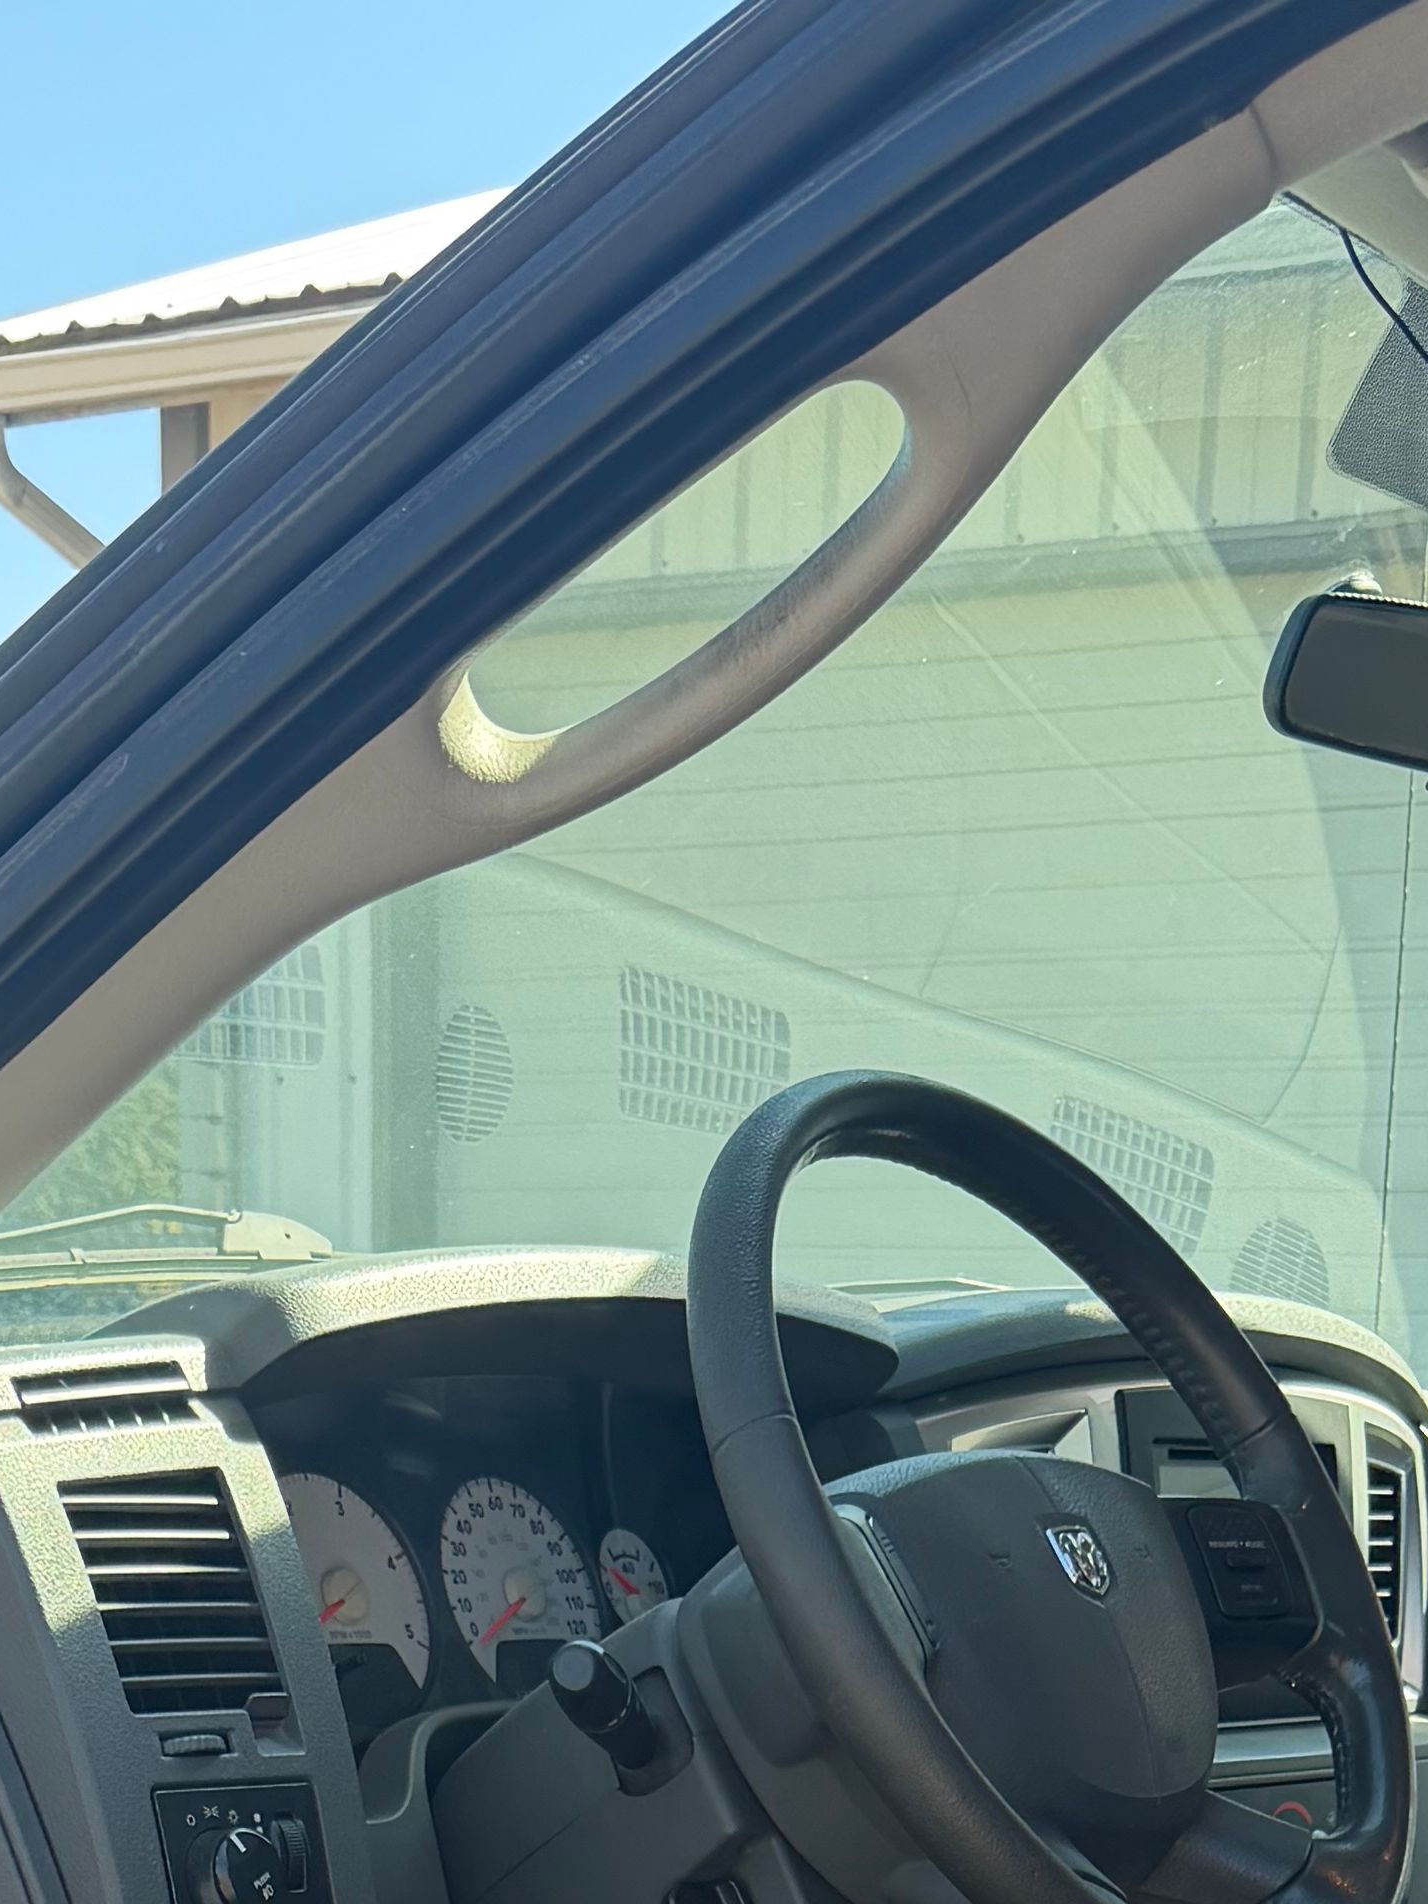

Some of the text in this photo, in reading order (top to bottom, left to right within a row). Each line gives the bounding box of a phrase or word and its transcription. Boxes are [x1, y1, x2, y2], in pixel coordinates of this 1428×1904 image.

[335, 1501, 345, 1516] 3
[488, 1496, 504, 1511] 60
[468, 1503, 485, 1520] 50
[510, 1504, 526, 1519] 70
[456, 1521, 472, 1536] 40
[530, 1521, 545, 1536] 80
[450, 1541, 467, 1557] 30
[546, 1541, 563, 1556] 90
[387, 1555, 397, 1571] 4
[452, 1569, 468, 1584] 20
[556, 1568, 578, 1584] 100
[457, 1598, 472, 1613] 10
[565, 1596, 584, 1611] 110
[404, 1624, 414, 1640] 5
[470, 1622, 479, 1637] 0
[567, 1620, 588, 1636] 120
